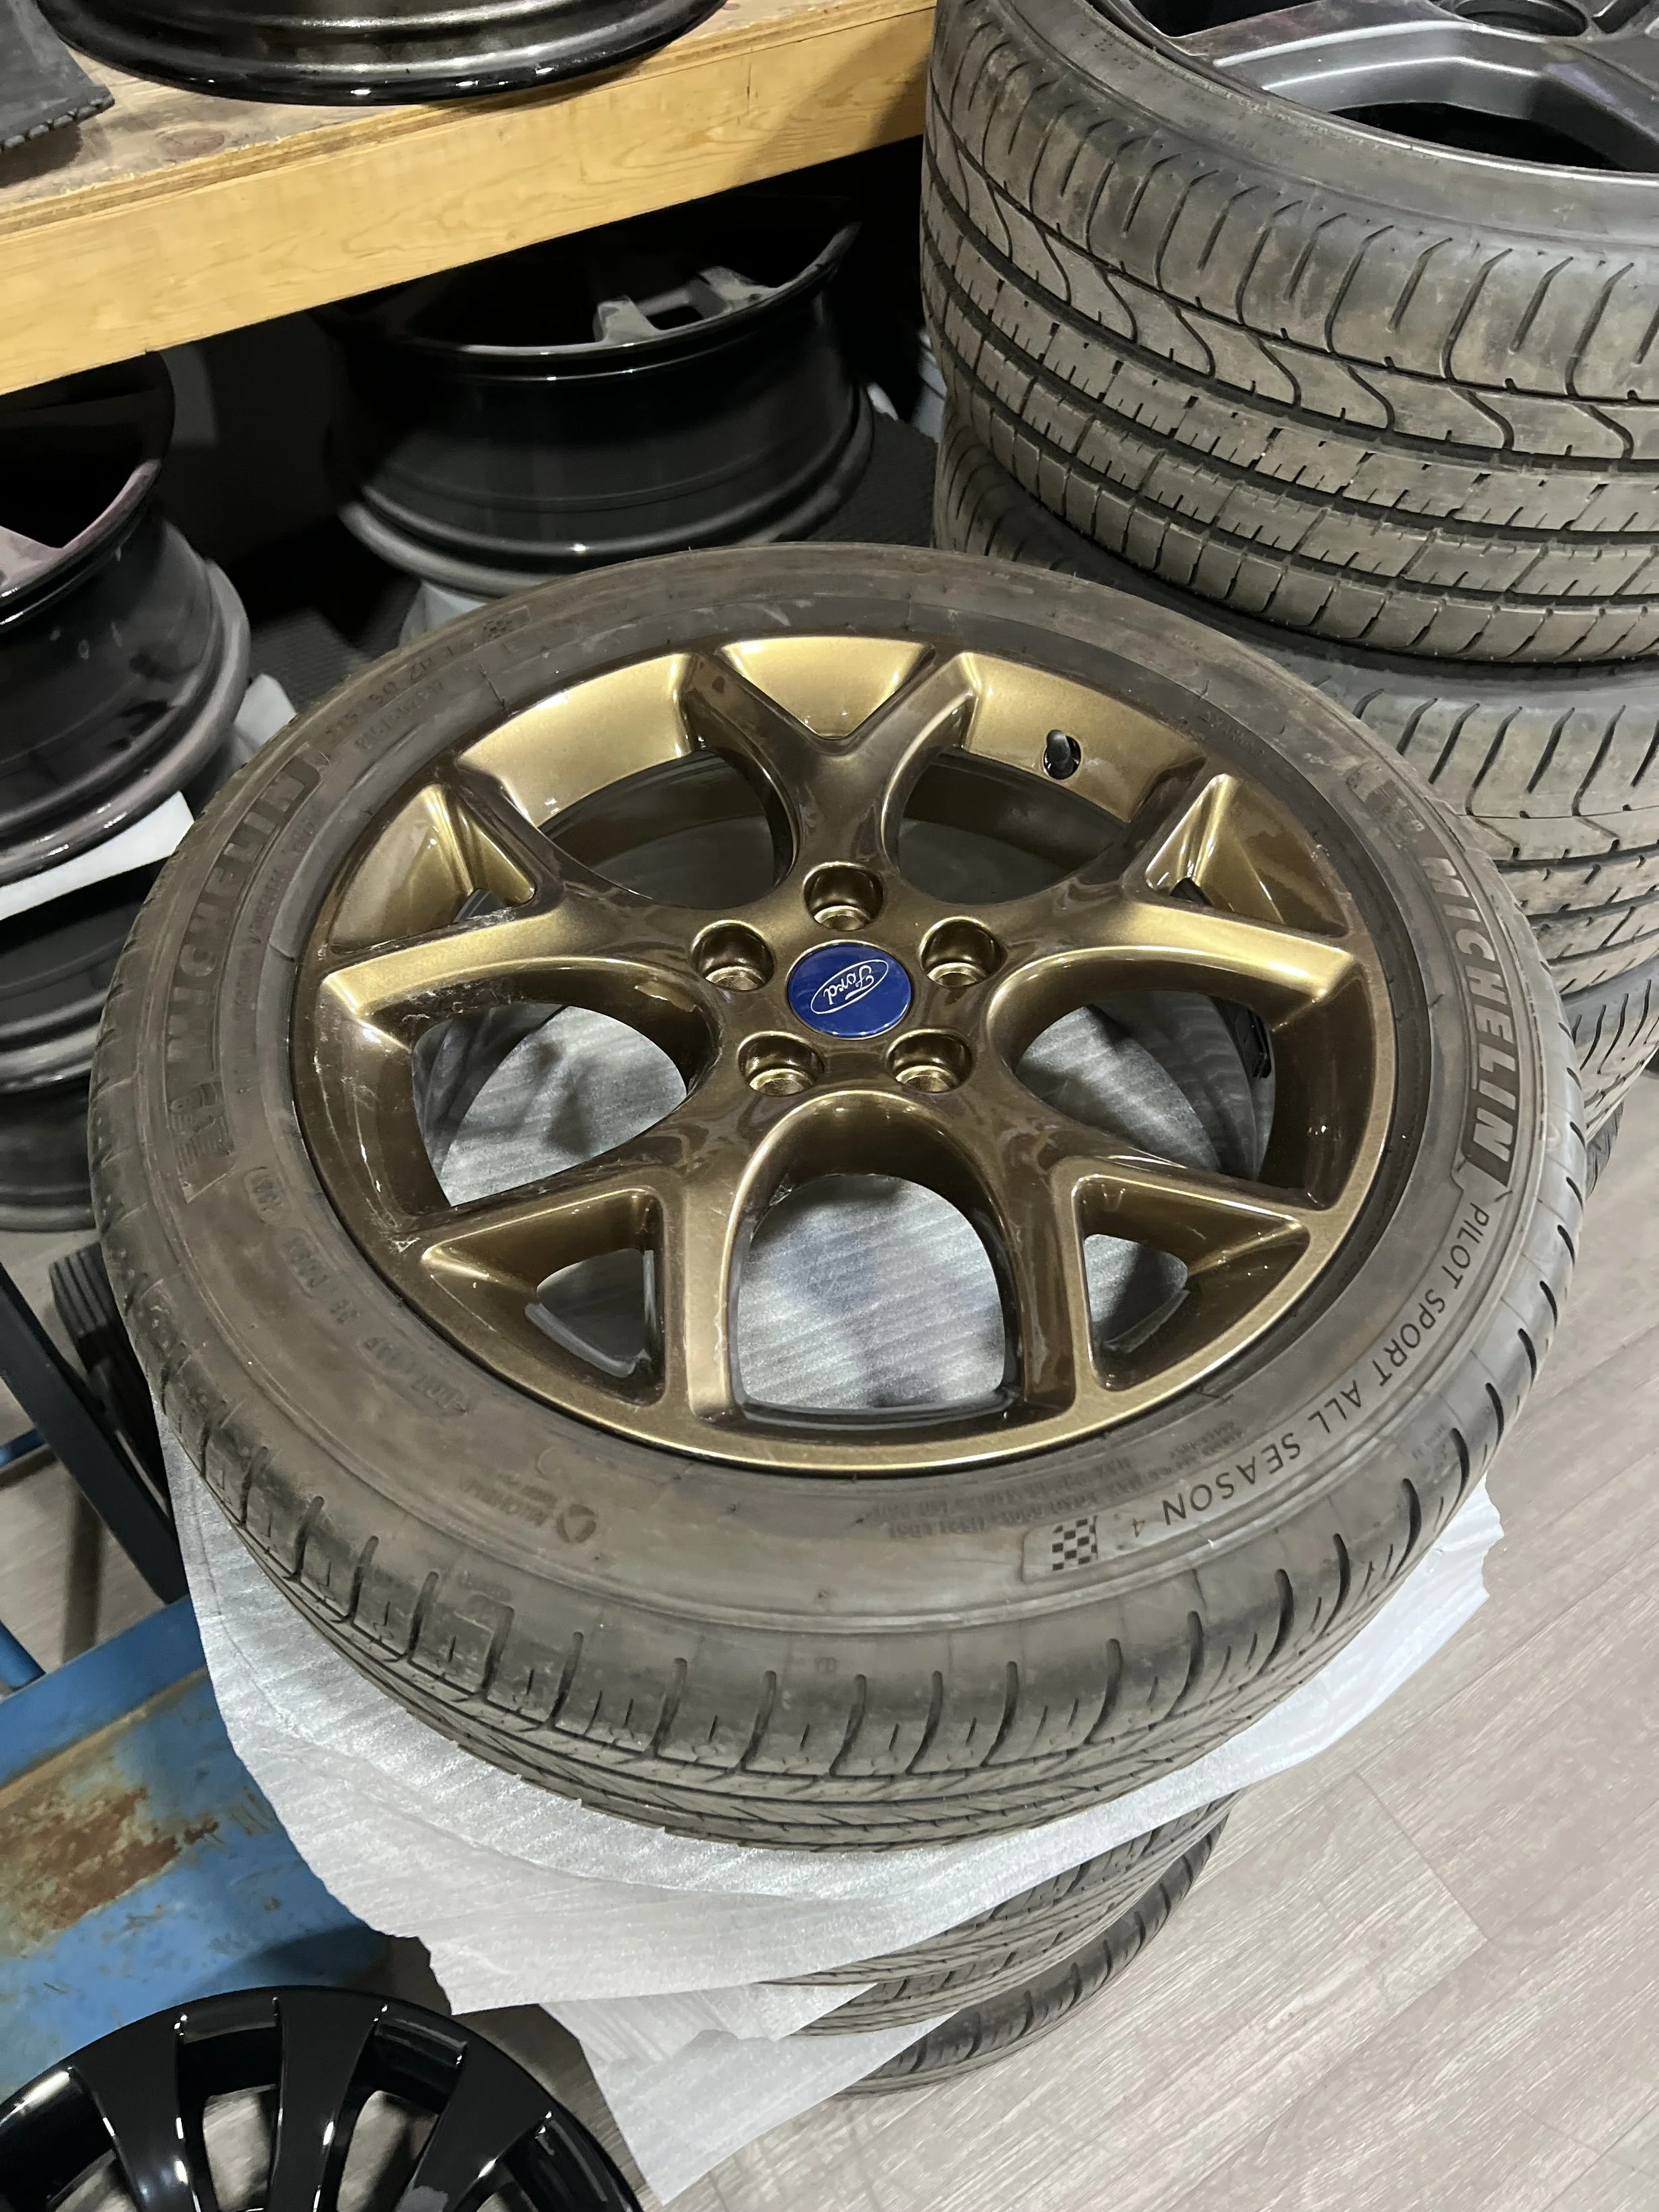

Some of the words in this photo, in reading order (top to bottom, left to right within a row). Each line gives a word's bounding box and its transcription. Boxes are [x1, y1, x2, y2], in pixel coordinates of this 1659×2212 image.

[167, 774, 305, 1062] MICHELIN
[823, 965, 875, 1005] Ford
[1422, 857, 1518, 1162] MICHELIN
[1441, 1202, 1489, 1290] PILOT
[1372, 1289, 1445, 1386] SPORT
[1307, 1379, 1361, 1433] ALL
[1162, 1432, 1301, 1525] SEASON
[1131, 1518, 1146, 1538] 4
